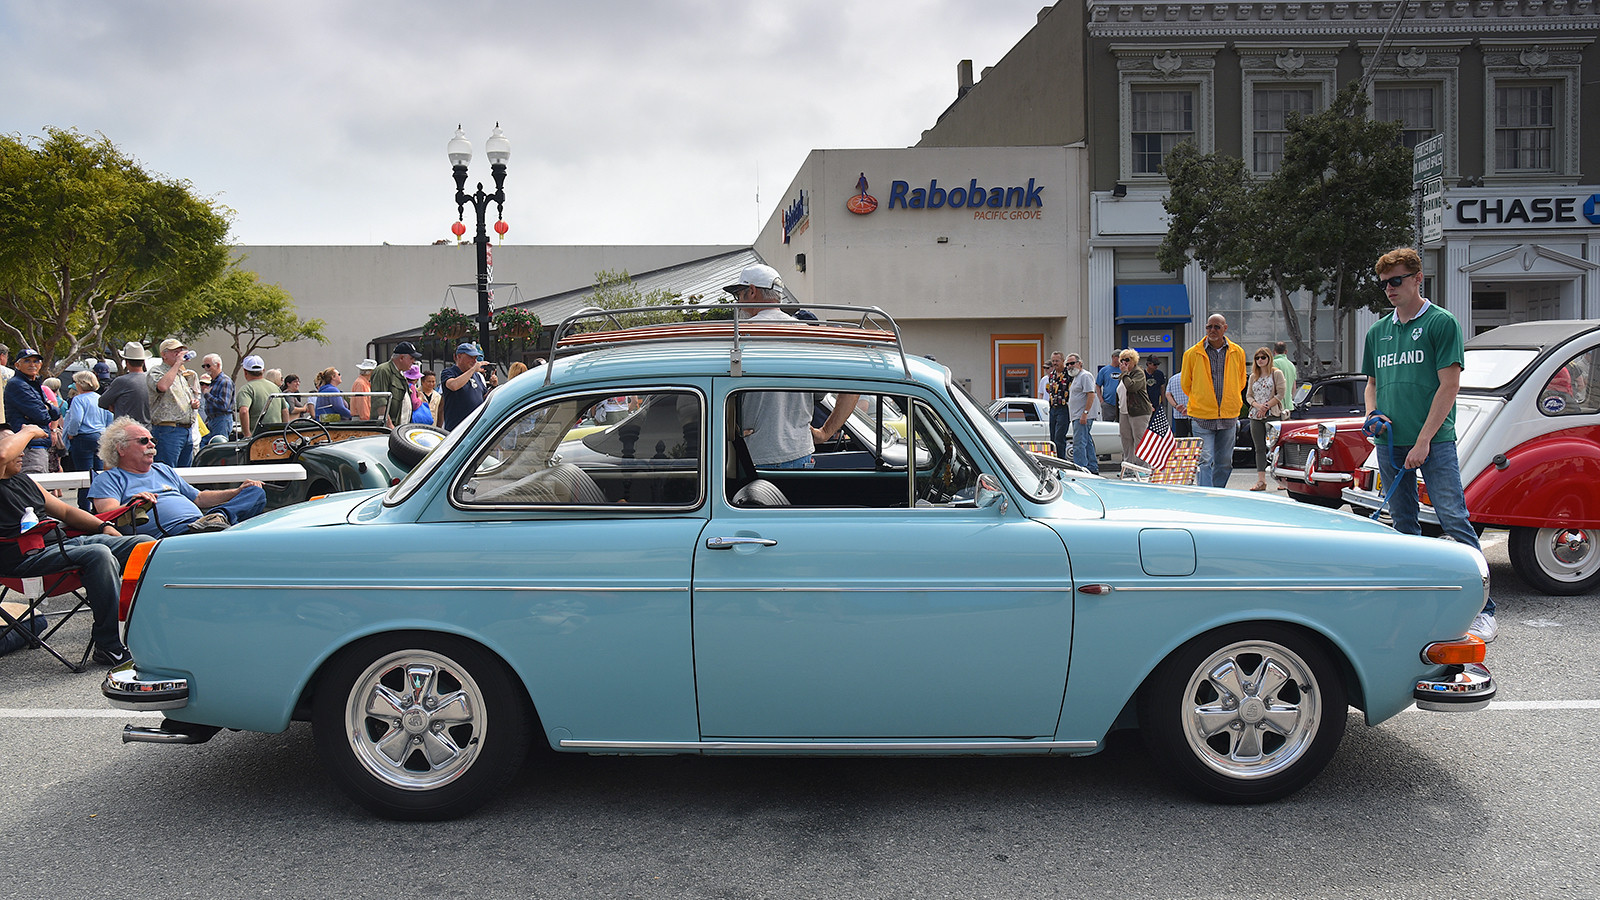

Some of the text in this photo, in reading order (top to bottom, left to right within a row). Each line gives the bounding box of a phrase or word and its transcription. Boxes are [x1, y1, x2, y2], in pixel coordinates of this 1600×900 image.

[888, 178, 1045, 209] Rabobank
[1423, 196, 1441, 212] PARKING
[1457, 198, 1577, 224] CHASE
[974, 210, 1042, 221] PACIFIC GROVE
[1146, 305, 1172, 317] ATM
[1130, 335, 1162, 343] CHASE
[1377, 350, 1424, 369] IRELAND
